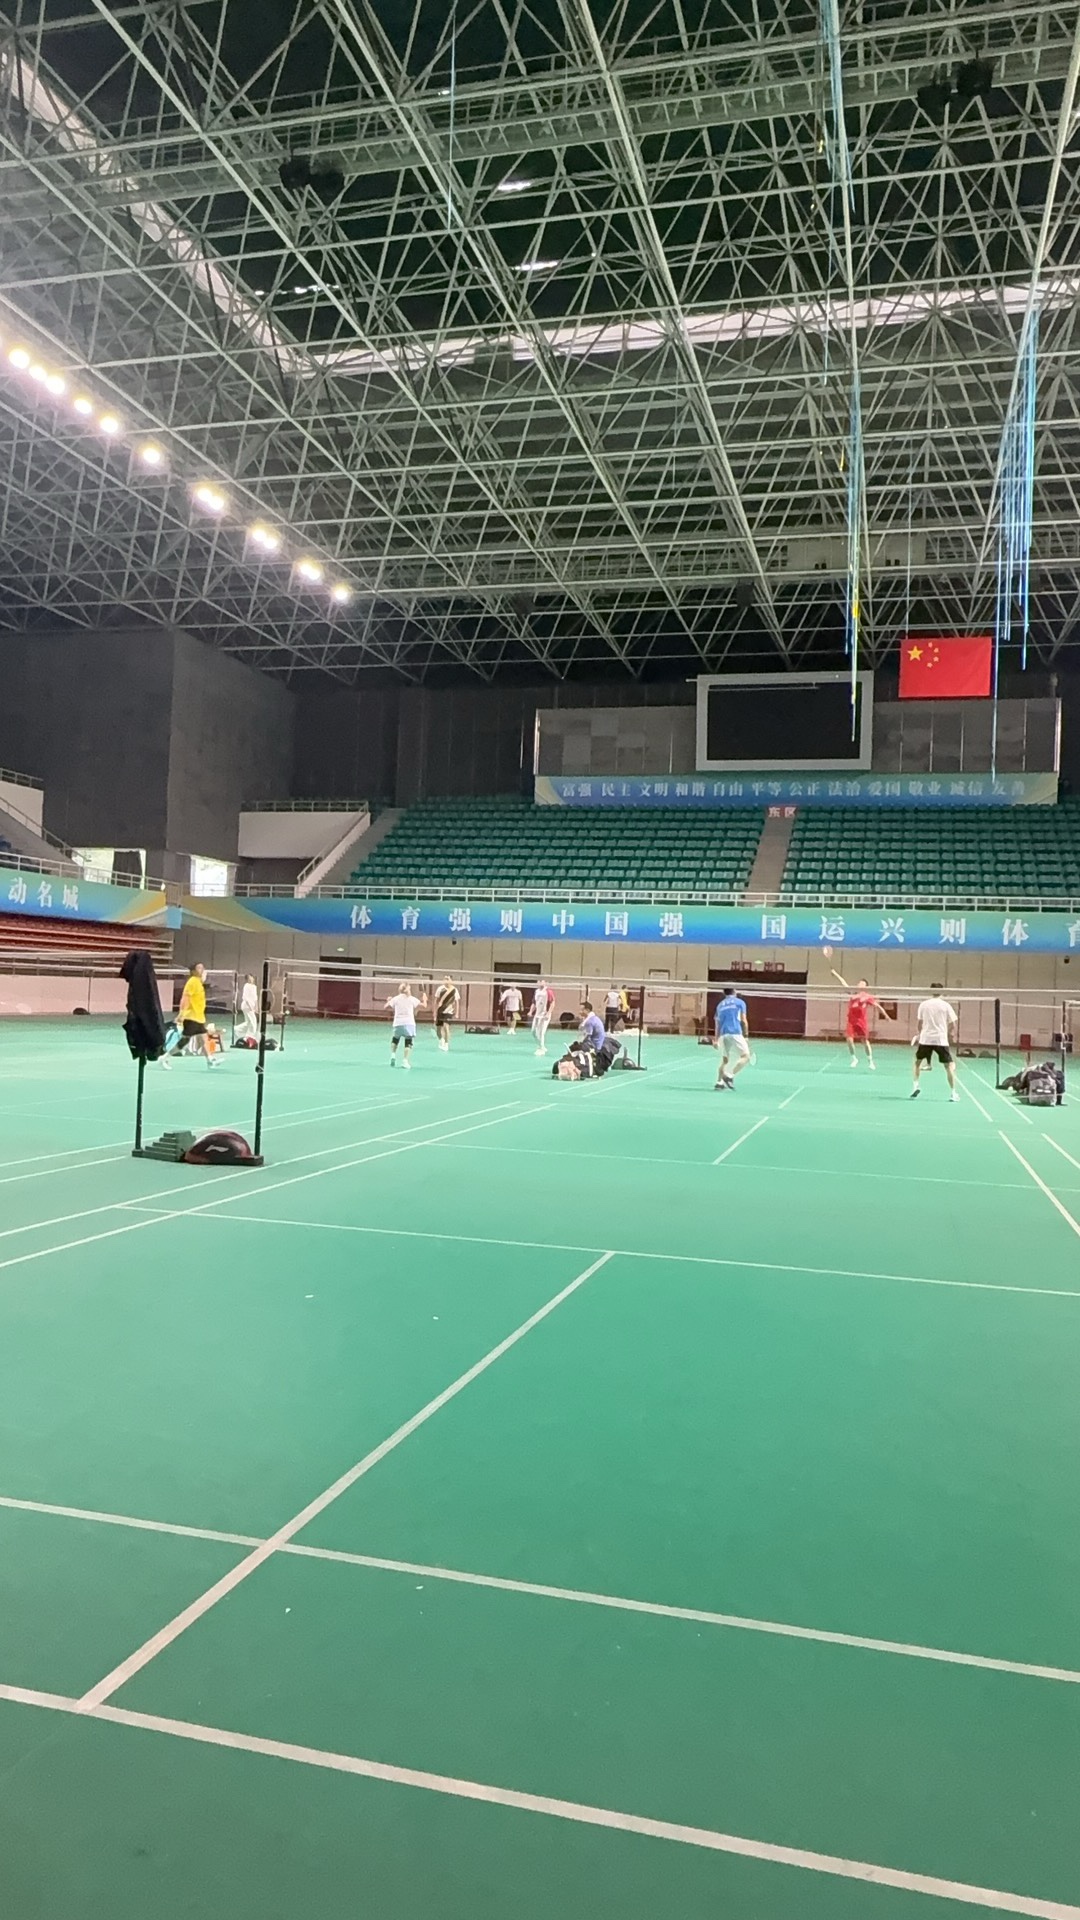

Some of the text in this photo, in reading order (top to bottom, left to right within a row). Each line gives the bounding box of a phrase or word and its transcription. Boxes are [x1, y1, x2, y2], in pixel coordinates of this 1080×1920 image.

[562, 780, 1025, 797] 富强 民主 文明 和谐 自由 平等 公正 法治 爱国 敬业 诚信 友善
[769, 806, 796, 818] 东区
[8, 877, 79, 911] 动名城
[350, 905, 684, 937] 体育强则中国强
[731, 961, 785, 973] 出口 出口
